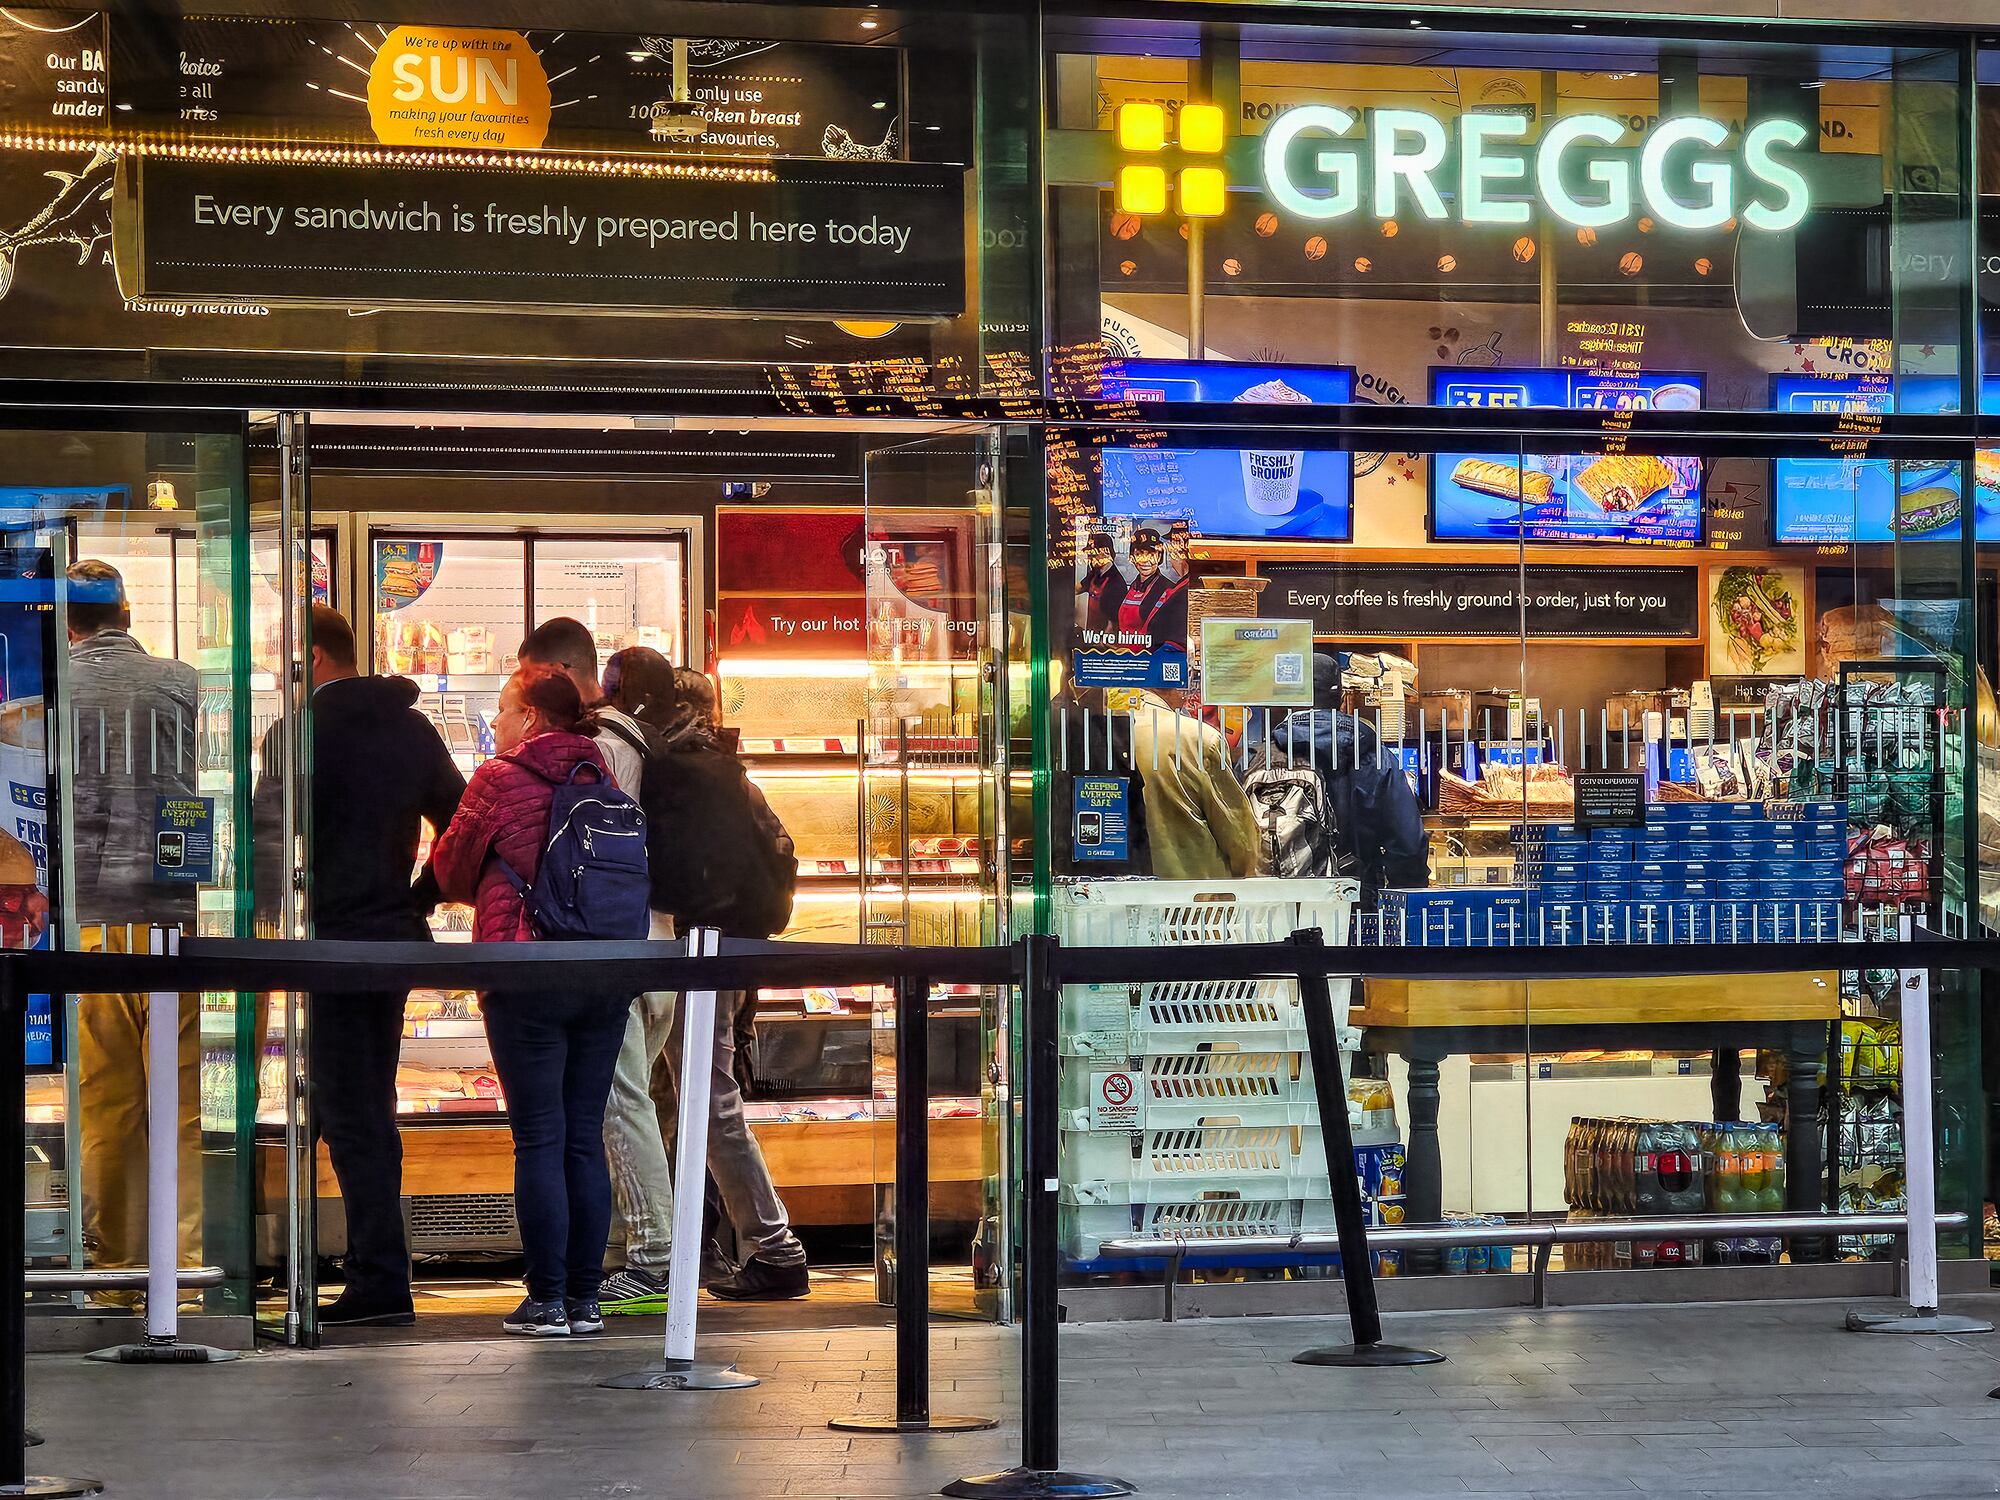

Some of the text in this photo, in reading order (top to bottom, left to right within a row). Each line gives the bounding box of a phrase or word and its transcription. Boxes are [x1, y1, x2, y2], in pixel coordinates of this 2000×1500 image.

[405, 36, 438, 49] We're
[443, 40, 458, 51] up
[462, 39, 488, 50] with
[47, 53, 77, 70] Our
[392, 53, 518, 106] SUN
[695, 85, 730, 103] only
[734, 89, 763, 102] use
[389, 108, 529, 124] making your favourites
[750, 109, 801, 126] breast
[414, 126, 505, 143] fresh every day
[700, 131, 780, 149] savouries,
[1262, 103, 1810, 232] GREGGS
[195, 195, 911, 254] Every sandwich is freshly prepared here today
[1249, 452, 1295, 467] FRESHLY
[1251, 466, 1293, 480] GROUND
[1288, 589, 1666, 612] Every coffee is freshly ground to order, just for you
[770, 616, 796, 635] Try
[801, 620, 828, 632] our
[833, 615, 860, 631] hot
[1082, 630, 1152, 648] We're hiring
[1091, 799, 1112, 807] SAFE
